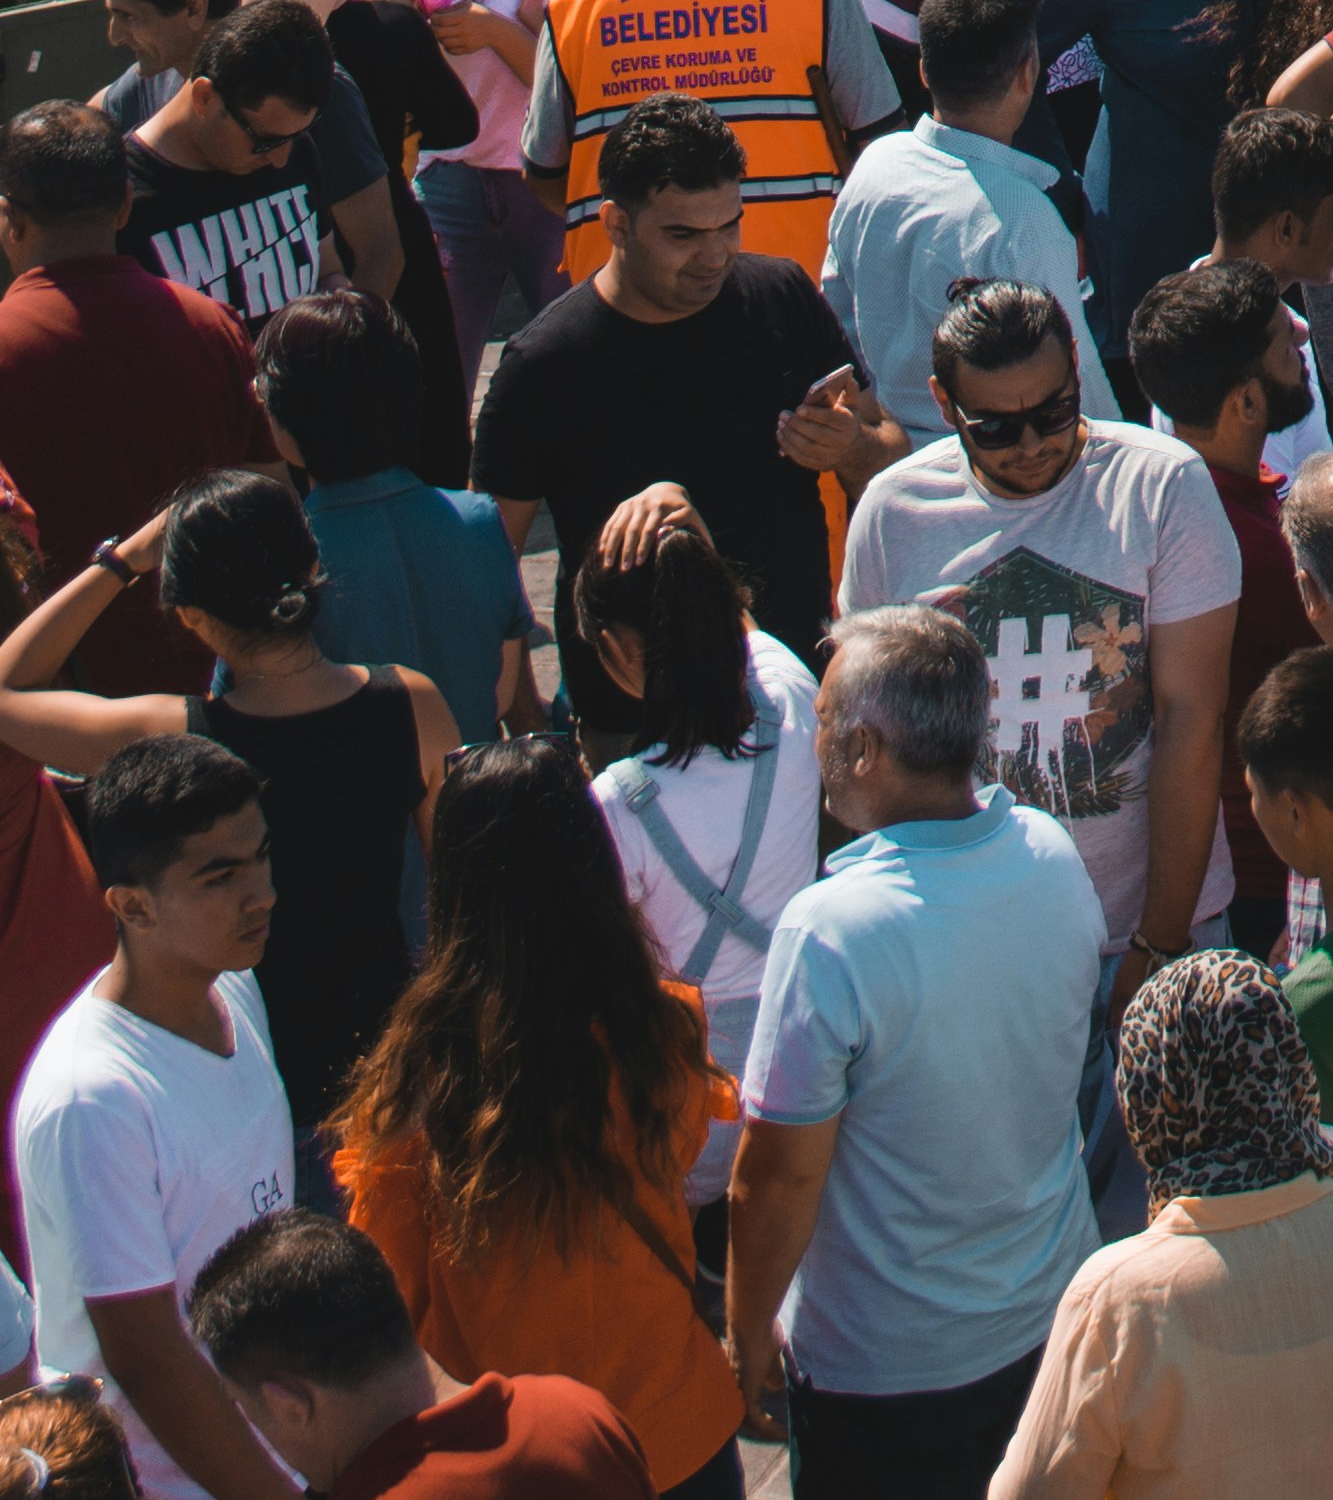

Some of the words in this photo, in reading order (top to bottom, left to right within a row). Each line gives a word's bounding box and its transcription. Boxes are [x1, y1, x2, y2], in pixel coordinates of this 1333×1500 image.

[611, 55, 661, 77] ÇEVRE
[665, 50, 732, 69] KORUMA
[736, 48, 757, 63] VE
[601, 76, 672, 97] KONTROL
[674, 66, 774, 89] MÜDÜRLÜĞÜ
